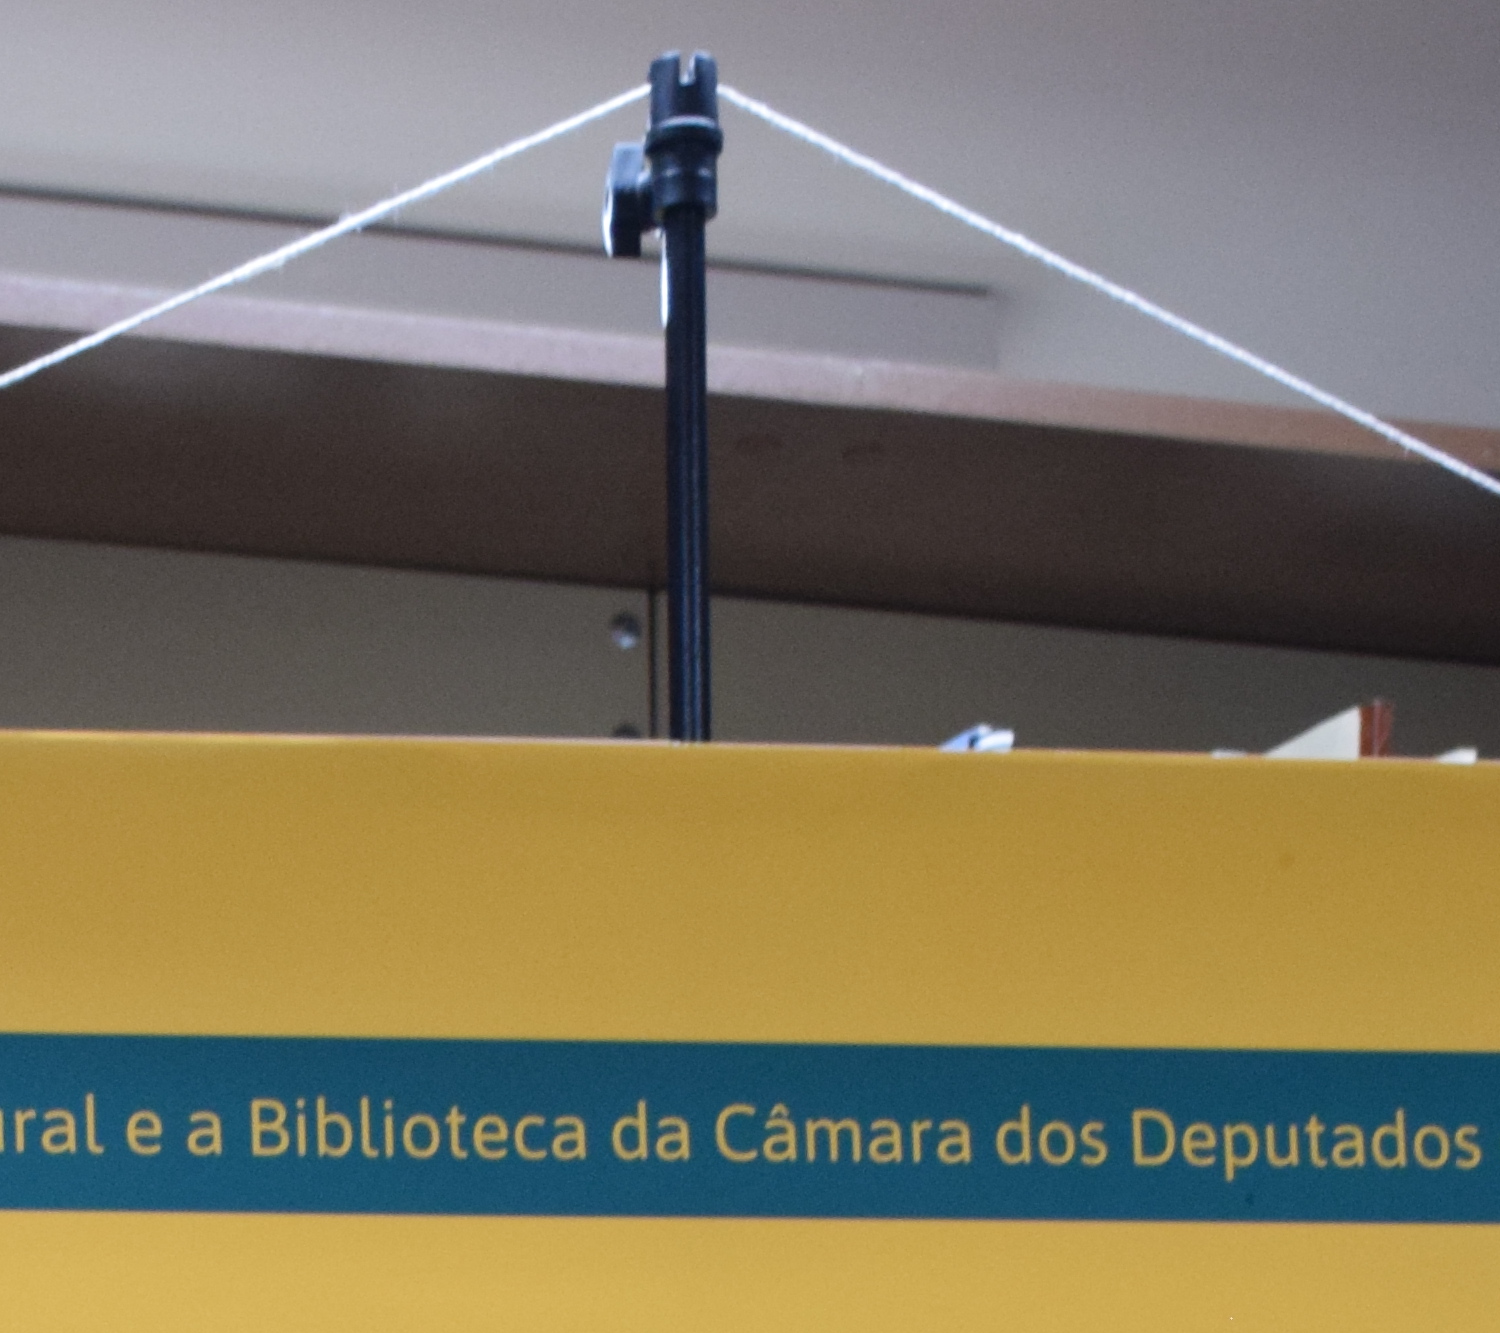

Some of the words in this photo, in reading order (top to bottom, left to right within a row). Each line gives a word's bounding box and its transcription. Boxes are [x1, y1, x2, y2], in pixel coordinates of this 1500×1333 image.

[125, 1109, 164, 1156] e
[186, 1110, 223, 1156] a
[249, 1096, 588, 1161] Biblioteca
[611, 1100, 691, 1161] da
[715, 1103, 972, 1164] Câmara
[995, 1105, 1108, 1166] dos
[1131, 1108, 1482, 1181] Deputados
